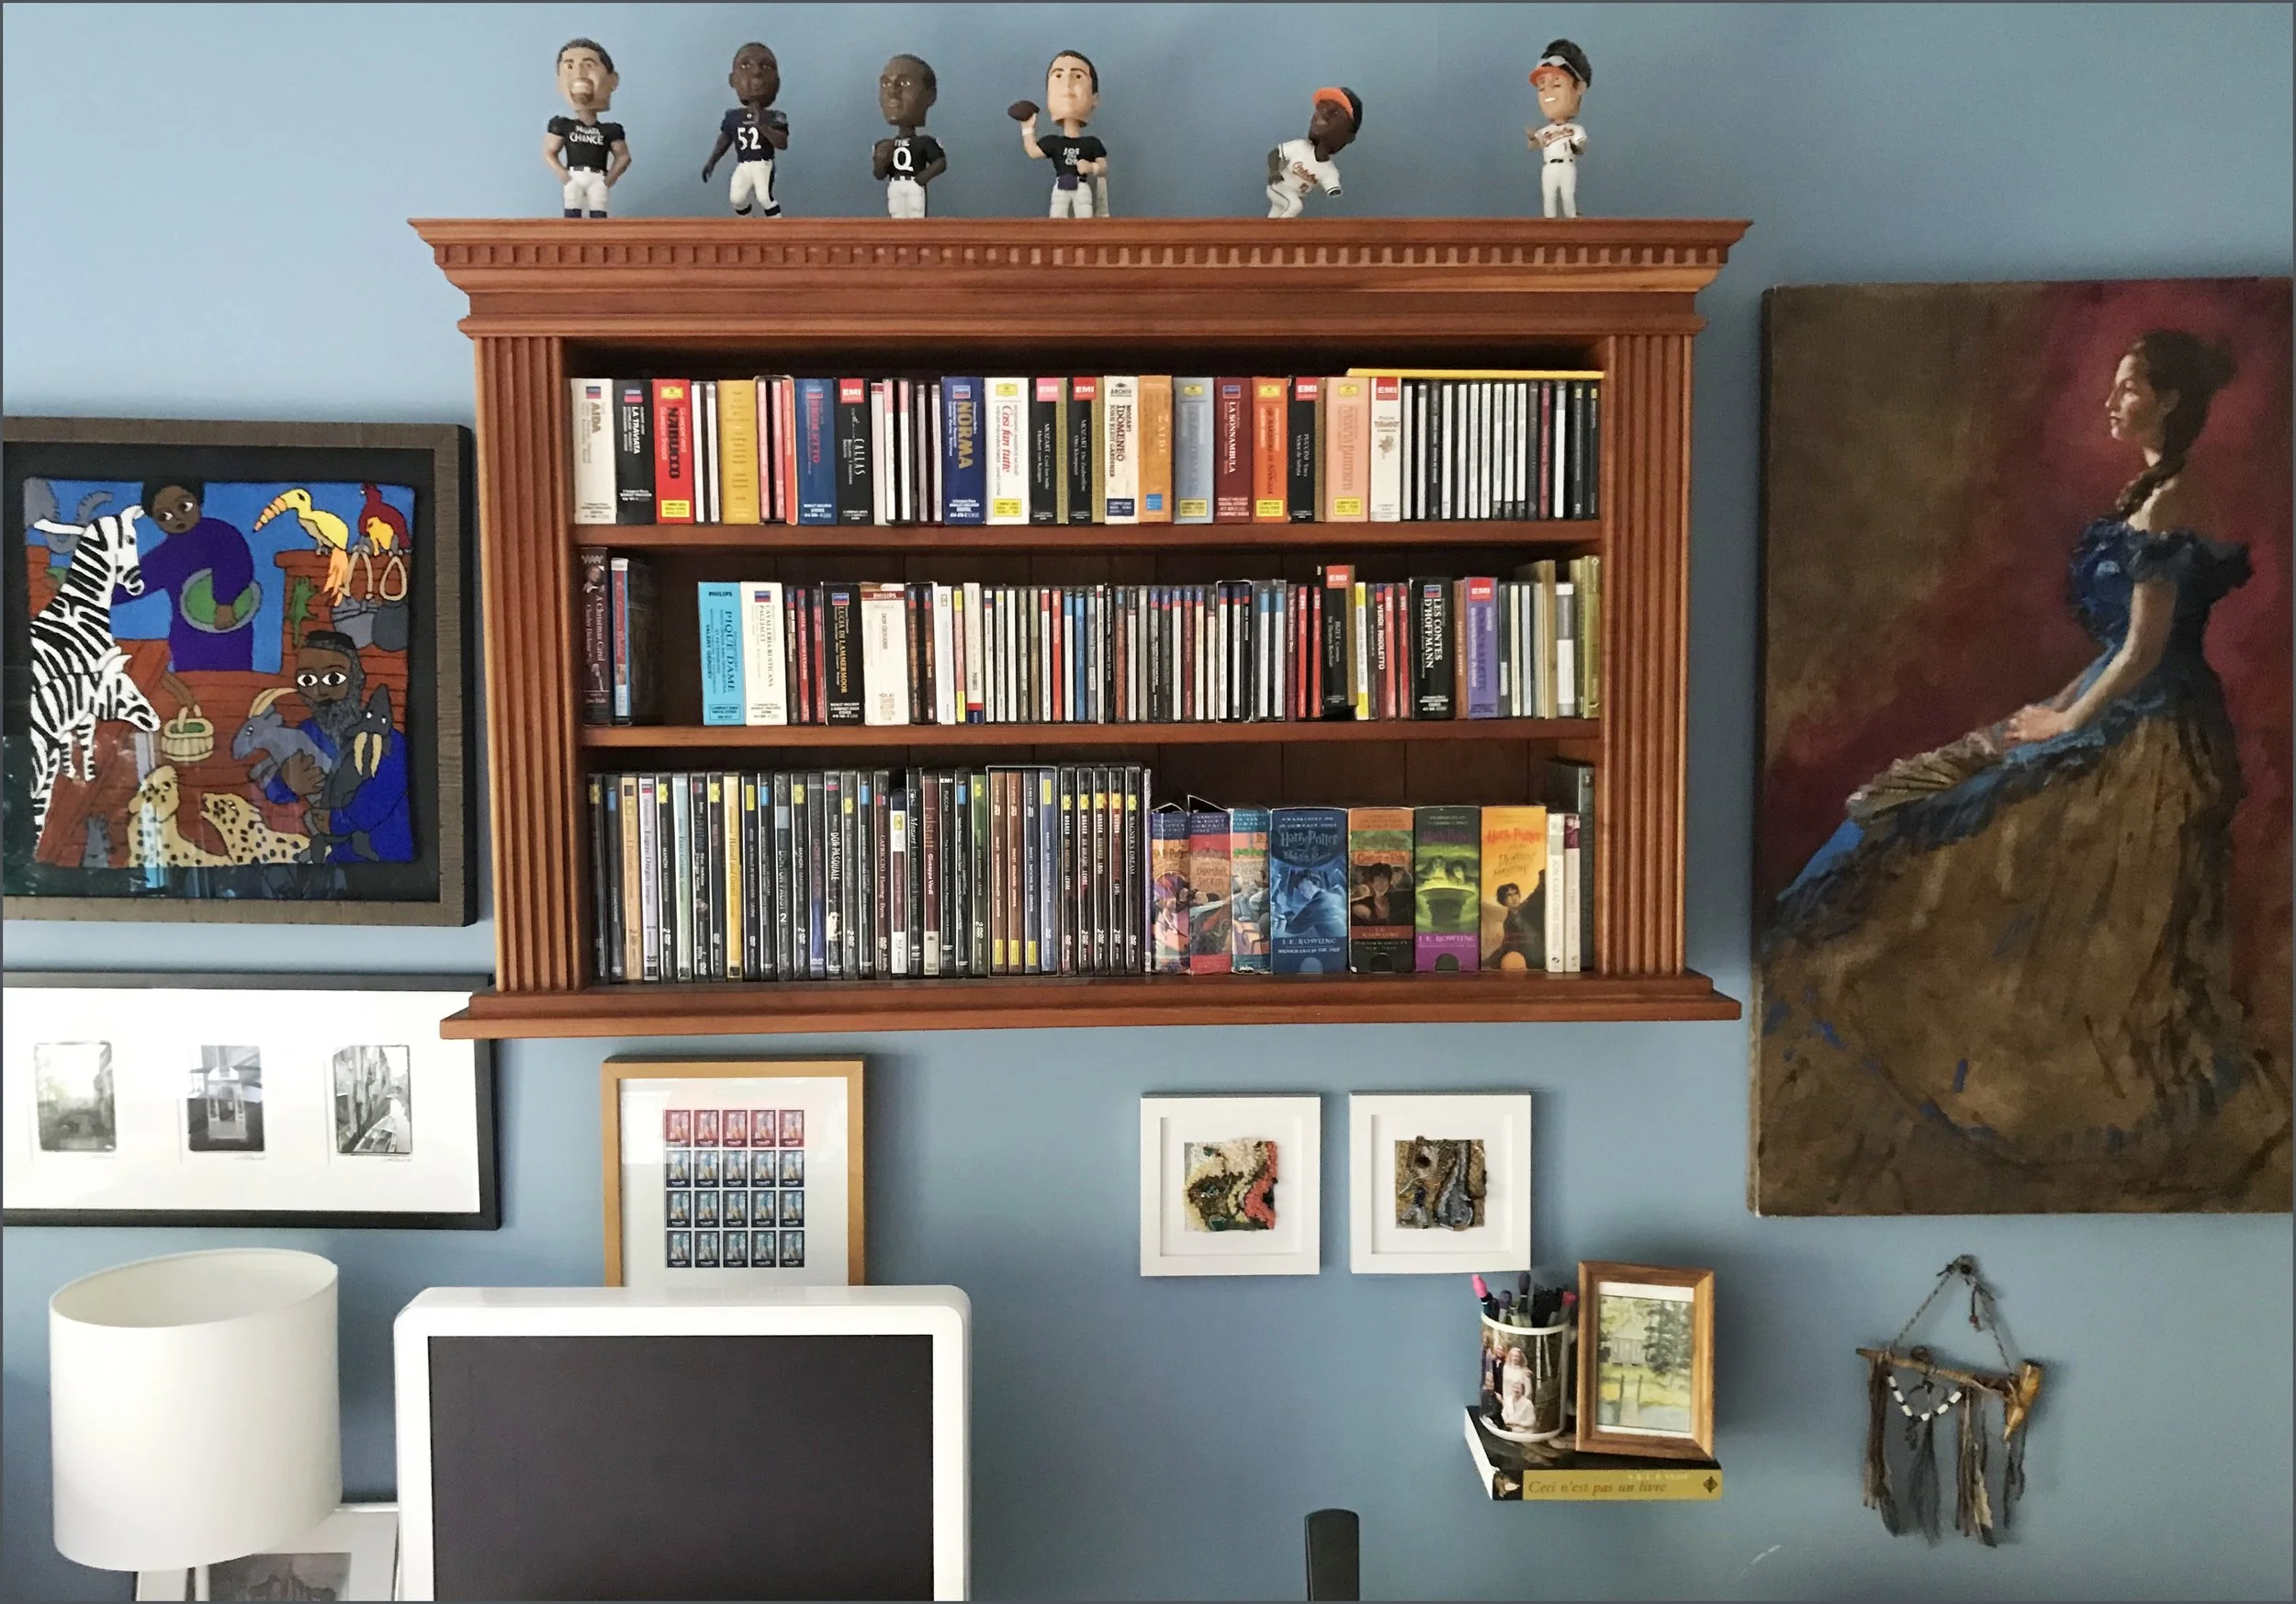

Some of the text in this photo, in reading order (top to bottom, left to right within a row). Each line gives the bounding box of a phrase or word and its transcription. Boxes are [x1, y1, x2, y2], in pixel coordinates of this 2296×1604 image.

[568, 131, 604, 145] CHANCE
[737, 126, 761, 150] 52
[893, 146, 914, 172] Q
[1063, 147, 1081, 156] JOE
[842, 389, 861, 397] EMI
[1075, 385, 1095, 394] EMI
[1298, 385, 1317, 393] EMI
[632, 407, 639, 418] LA
[1229, 401, 1235, 412] LA
[591, 402, 601, 434] AIDA
[958, 401, 973, 469] NORMA
[1001, 429, 1012, 446] fan
[1116, 405, 1125, 461] IDOMENEO
[854, 438, 865, 475] CALLAS
[1002, 448, 1012, 472] tutte
[838, 606, 846, 628] LUCIA
[1433, 599, 1442, 617] LES
[838, 630, 846, 638] DI
[1424, 599, 1434, 668] D'HOFFMANN
[725, 611, 735, 693] PIQUE DAME
[910, 817, 918, 844] Mozart
[924, 807, 936, 849] Falstaff
[1280, 830, 1339, 847] Harry Potter
[830, 832, 840, 881] DON PASQUALE
[1528, 1480, 1668, 1497] Ceci n'est pas un livre
